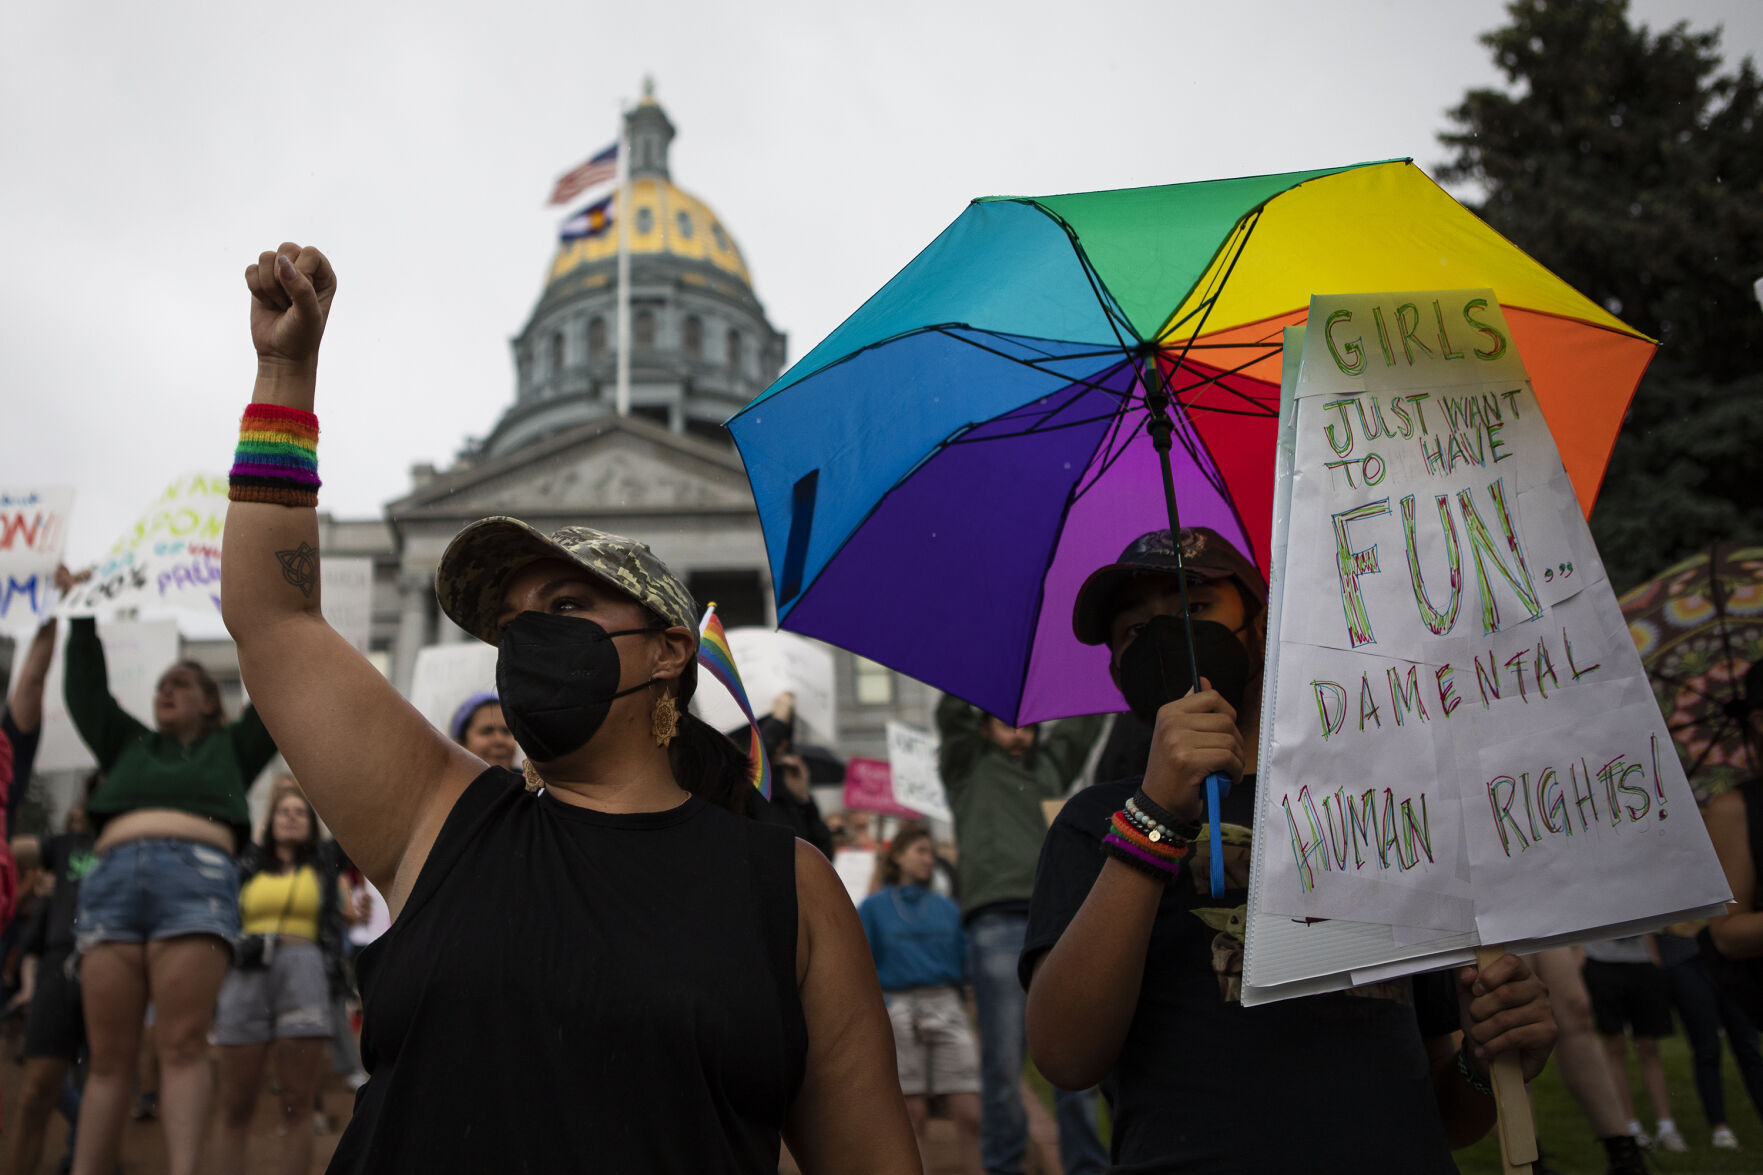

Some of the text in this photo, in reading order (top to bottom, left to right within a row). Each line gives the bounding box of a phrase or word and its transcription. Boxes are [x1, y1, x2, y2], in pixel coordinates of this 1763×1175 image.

[1324, 298, 1507, 376] GIRLS
[1322, 390, 1522, 458] JUST WANT
[1324, 423, 1513, 489] TO HAVE
[1312, 627, 1600, 742] DAMENTAL
[1282, 732, 1667, 893] HUMAN RIGHTS!
